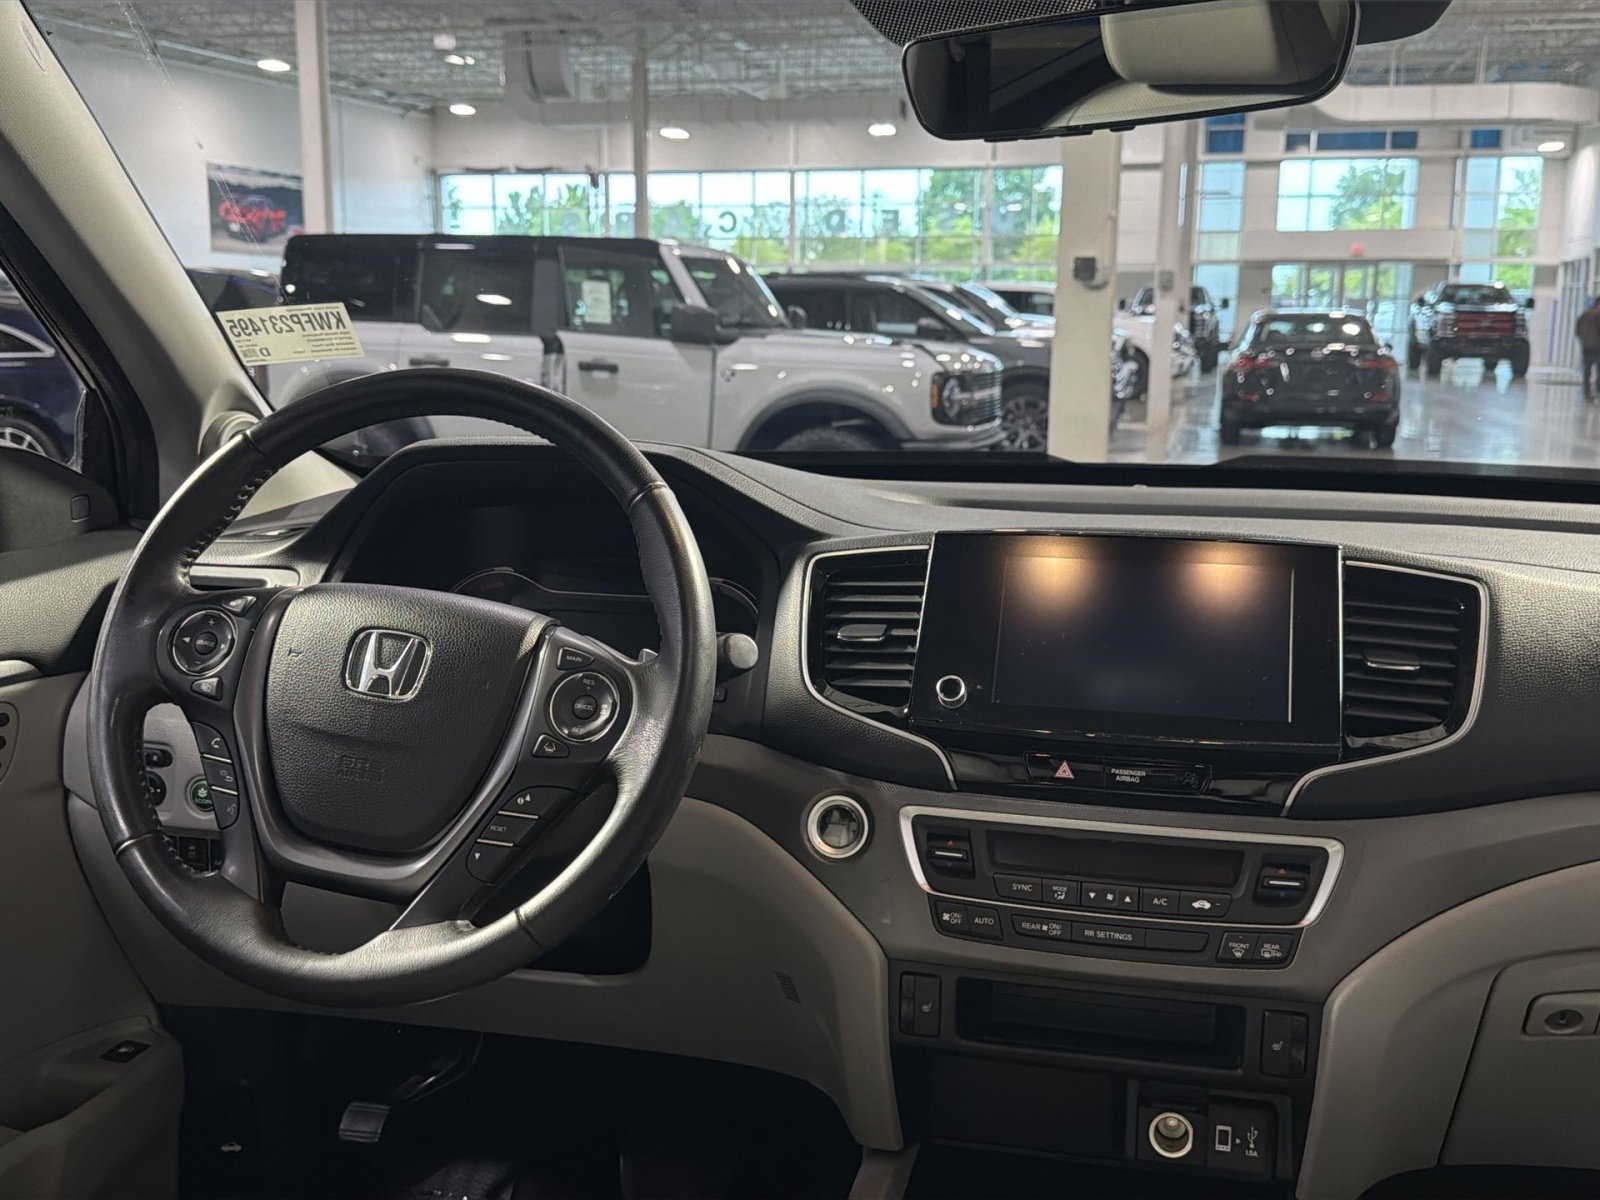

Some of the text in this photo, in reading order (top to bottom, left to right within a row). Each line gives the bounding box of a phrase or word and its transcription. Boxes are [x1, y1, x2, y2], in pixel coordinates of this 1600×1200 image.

[1111, 768, 1146, 777] PASSENGER
[1115, 775, 1140, 783] AIRBAG
[1012, 883, 1033, 892] SYNC
[1153, 897, 1168, 906] A/C
[974, 917, 994, 925] AUTO
[1021, 922, 1041, 930] REAR
[1096, 930, 1132, 941] SETTINGS
